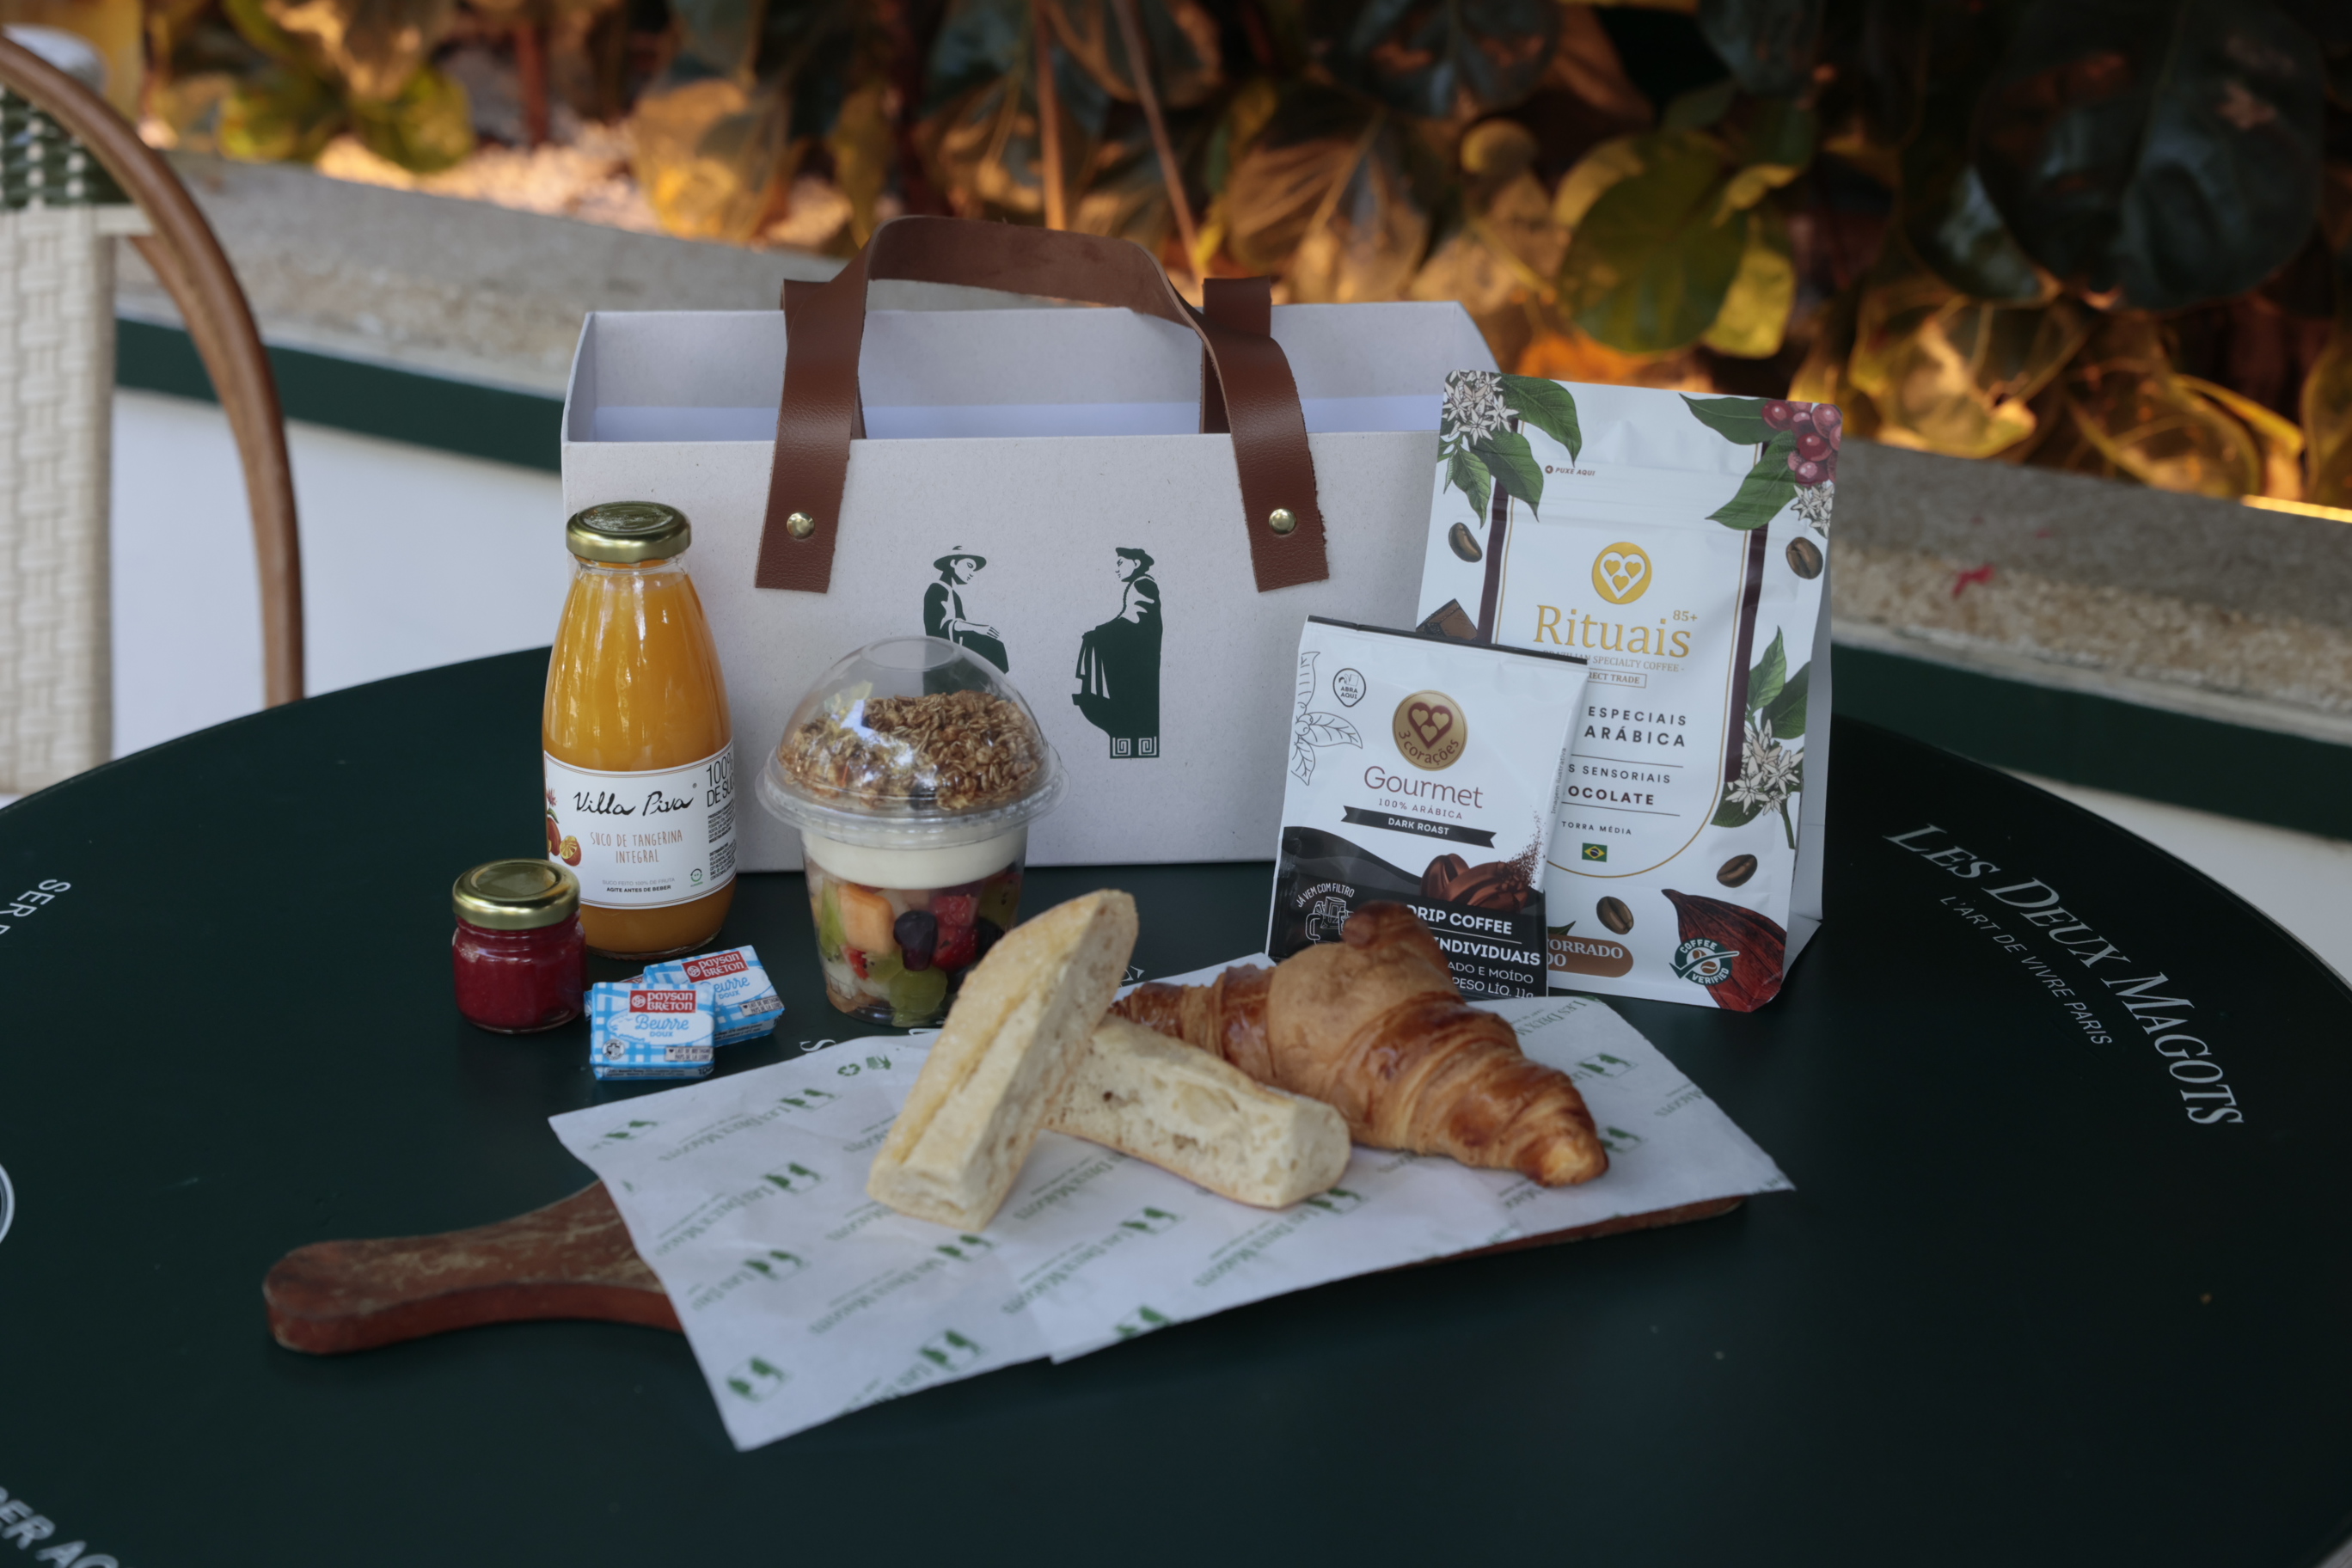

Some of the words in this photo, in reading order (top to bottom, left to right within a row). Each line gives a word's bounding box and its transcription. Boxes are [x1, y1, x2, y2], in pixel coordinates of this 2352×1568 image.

[1672, 609, 1698, 622] 85+
[1533, 604, 1691, 658] Rituais
[1592, 655, 1641, 669] SPECIALTY
[1643, 661, 1679, 672] COFFEE
[1611, 673, 1640, 684] TRADE
[1588, 706, 1687, 726] ESPECIAIS
[1398, 730, 1412, 740] 3
[1584, 724, 1686, 747] ARÁBICA
[1403, 738, 1460, 766] corações
[1550, 784, 1561, 814] Imagem
[1557, 748, 1567, 784] ilustrativa
[1582, 765, 1670, 784] SENSORIAIS
[707, 785, 721, 808] DE
[1364, 765, 1484, 809] Gourmet
[1567, 785, 1654, 805] OCOLATE
[573, 791, 636, 816] Villa
[642, 790, 695, 817] Piva
[1378, 798, 1408, 811] 100%
[1412, 805, 1462, 820] ARÁBICA
[1387, 817, 1415, 830] DARK
[1417, 822, 1450, 836] ROAST
[1561, 820, 1595, 831] TORRA
[1599, 824, 1632, 835] MÉDIA
[590, 831, 612, 847] SUCO
[616, 834, 628, 848] DE
[632, 829, 683, 848] TANGERINA
[616, 848, 660, 864] INTEGRAL
[1295, 894, 1306, 908] JÁ
[1302, 885, 1318, 900] VEM
[1316, 883, 1332, 895] COM
[1332, 882, 1356, 898] FILTRO
[1449, 912, 1512, 935] COFFEE
[1547, 938, 1624, 959] ORRADO
[1679, 939, 1718, 954] COFFEE
[1478, 965, 1485, 976] E
[1488, 968, 1534, 984] MOÍDO
[1692, 967, 1730, 985] VERIFIED
[1882, 823, 2001, 879] LES
[1981, 877, 2131, 968] DEUX
[2100, 971, 2245, 1124] MAGOTS
[1939, 896, 2001, 930] L'ART
[1993, 934, 2028, 953] DE
[2021, 956, 2076, 997] VIVRE
[2063, 1001, 2113, 1044] PARIS
[703, 977, 750, 993] eurre
[1452, 977, 1485, 992] PESO
[646, 1001, 693, 1011] BRETON
[634, 1014, 689, 1030] Beurre
